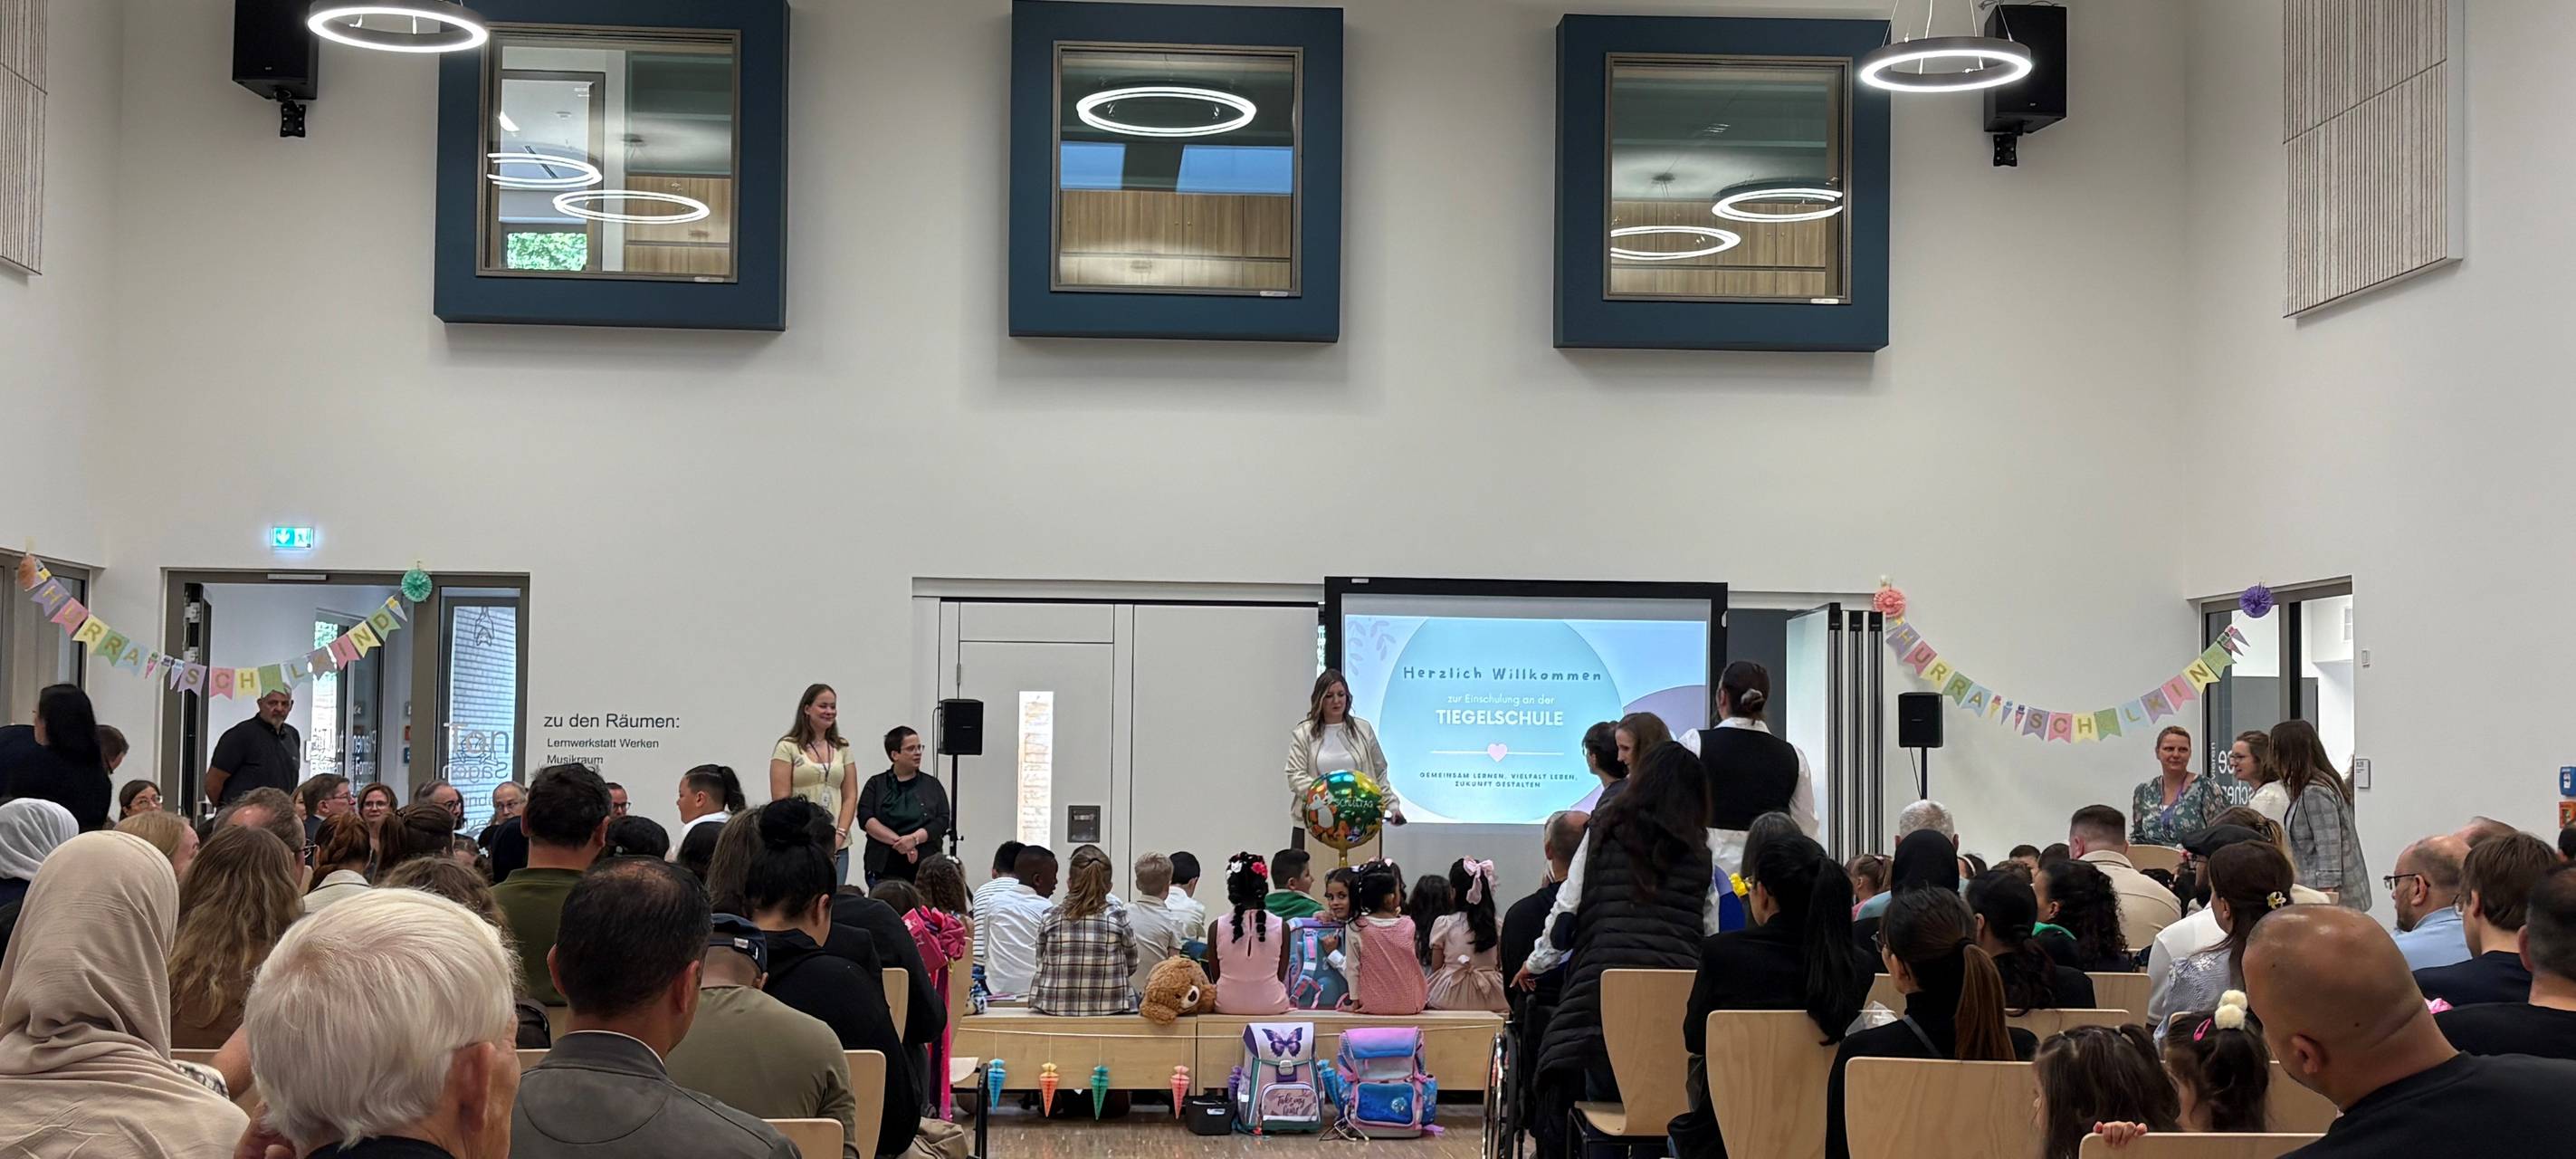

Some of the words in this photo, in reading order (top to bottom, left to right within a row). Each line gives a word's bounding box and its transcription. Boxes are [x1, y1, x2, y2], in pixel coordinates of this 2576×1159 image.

[43, 585, 139, 666] HURRA
[1404, 666, 1483, 679] Herzlich
[1493, 667, 1601, 681] Willkommen
[1897, 628, 1982, 708] HURRA
[1448, 695, 1463, 704] zur
[1465, 694, 1520, 707] Einschulung
[1538, 694, 1555, 704] der
[544, 715, 563, 728] zu
[568, 714, 599, 728] den
[606, 713, 680, 729] Räumen:
[1436, 709, 1564, 725] TIEGELSCHULE
[547, 738, 616, 748] Lernwerkstatt
[619, 739, 659, 748] Werken
[547, 754, 604, 765] Musikraum
